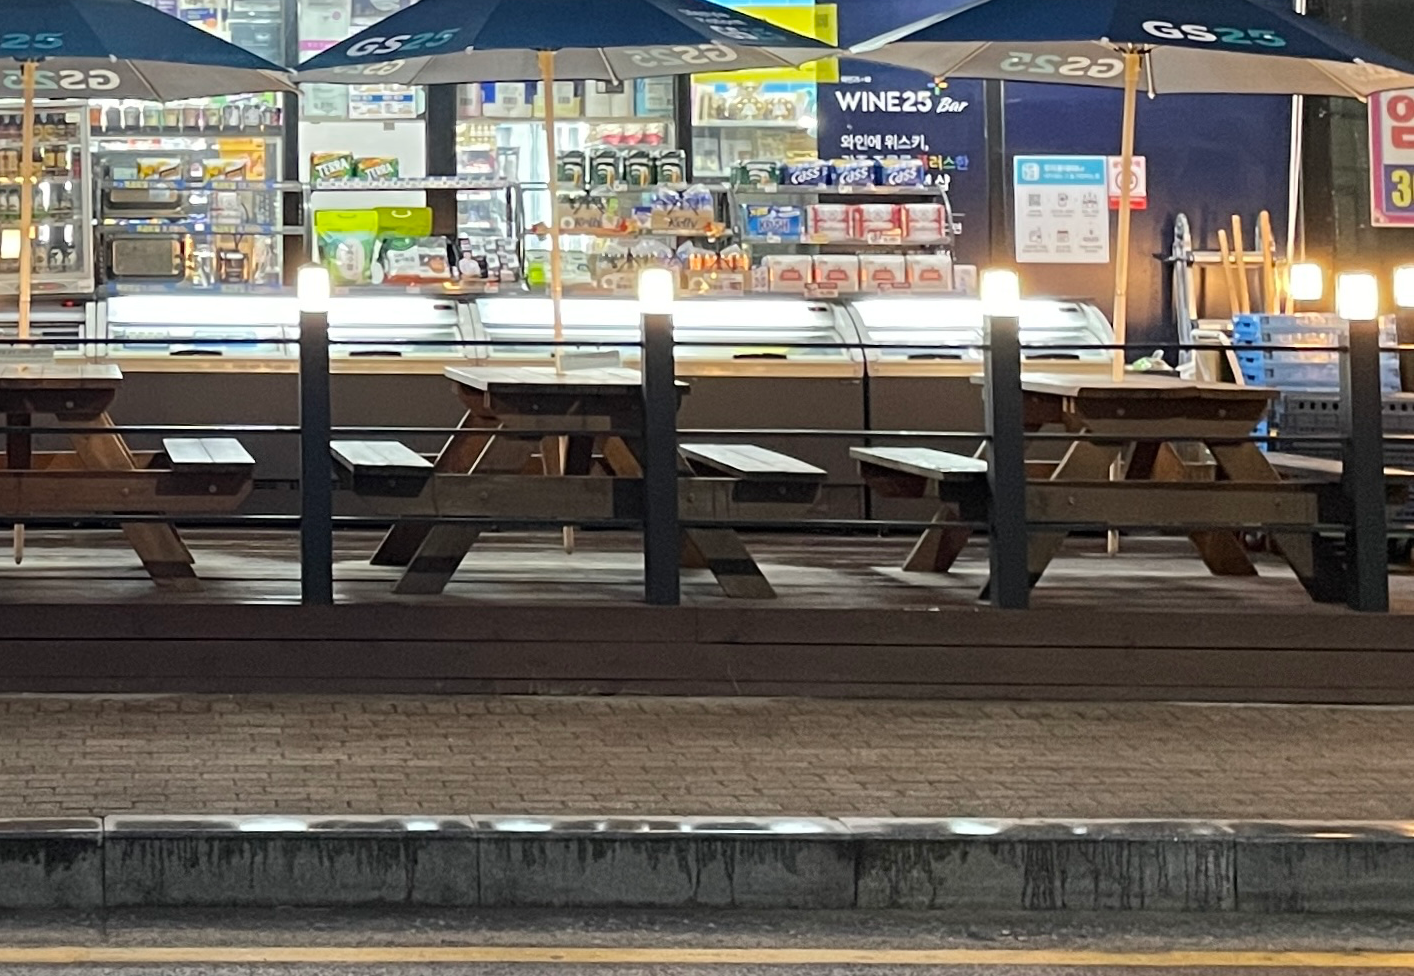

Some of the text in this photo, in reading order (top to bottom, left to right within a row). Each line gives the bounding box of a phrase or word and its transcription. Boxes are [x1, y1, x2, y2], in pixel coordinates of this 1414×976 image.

[346, 27, 461, 57] GS25
[1142, 20, 1286, 48] GS25
[835, 90, 969, 114] WINE25 Bar
[840, 133, 930, 152] 와인에 위스키,
